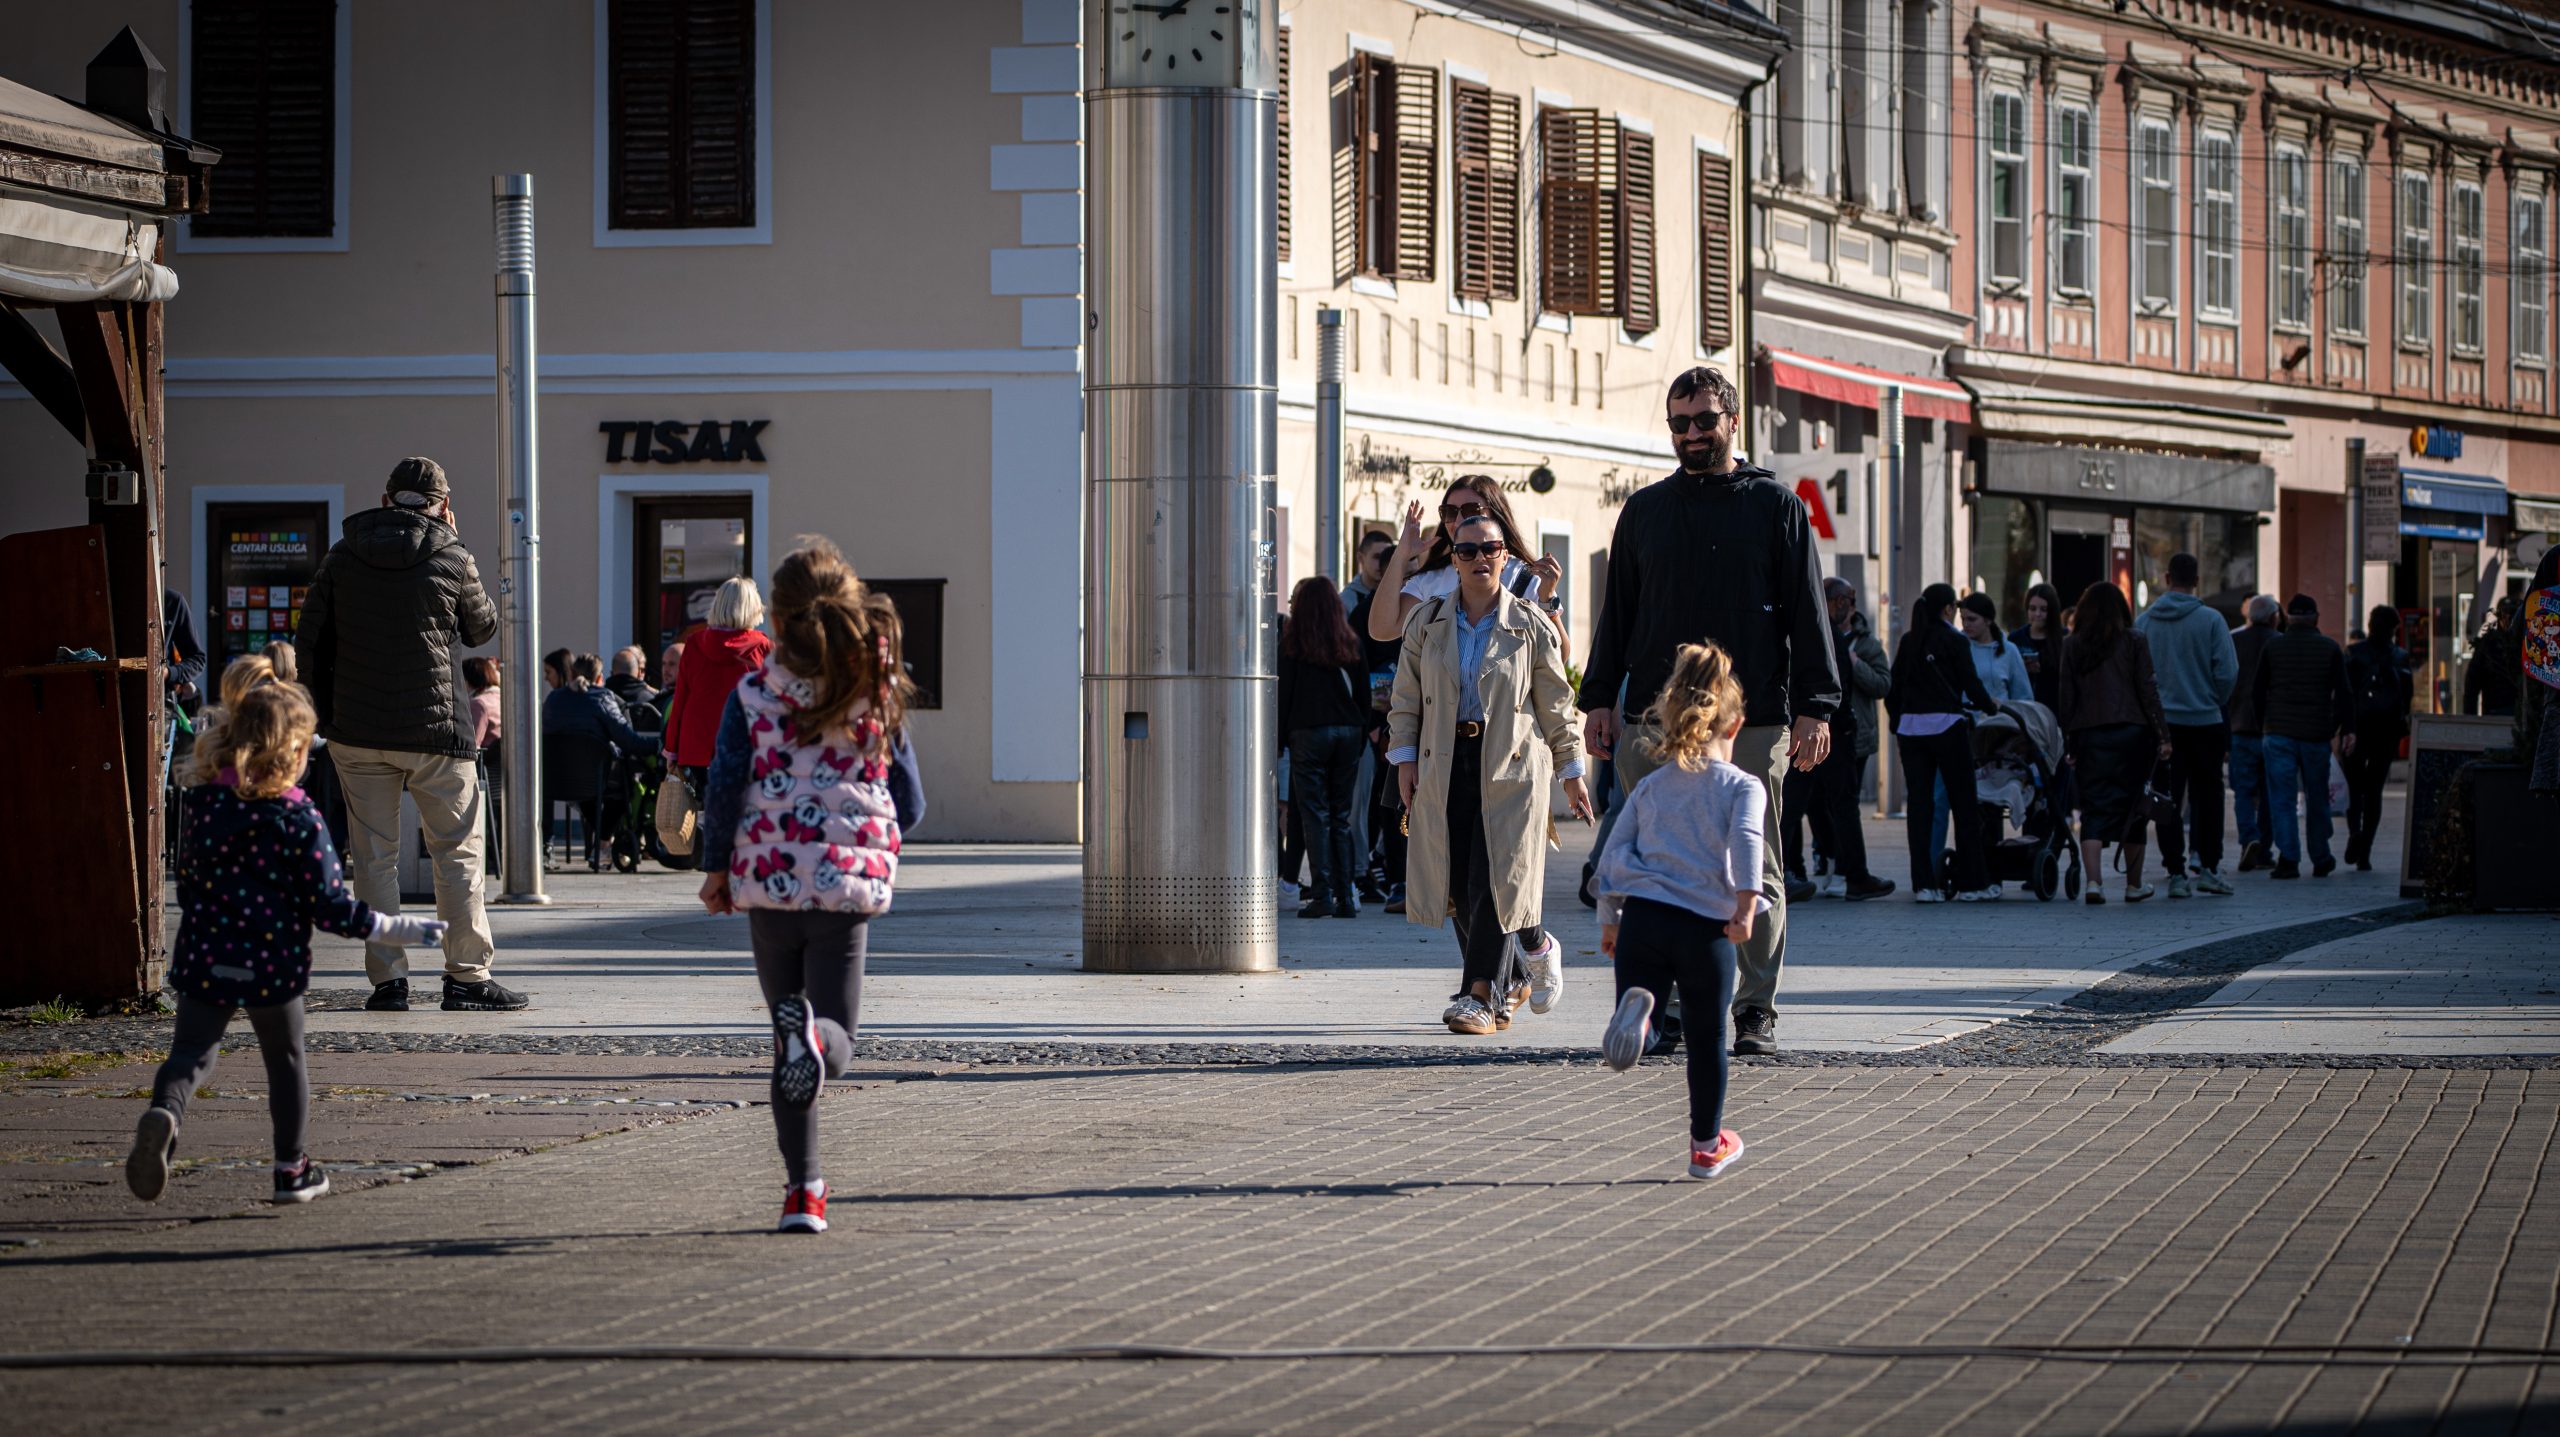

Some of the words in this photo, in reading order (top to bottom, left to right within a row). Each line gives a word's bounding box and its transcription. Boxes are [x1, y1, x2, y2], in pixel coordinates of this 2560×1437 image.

[599, 420, 771, 464] TISAK
[231, 543, 267, 553] CENTAR
[269, 543, 307, 553] USLUGA
